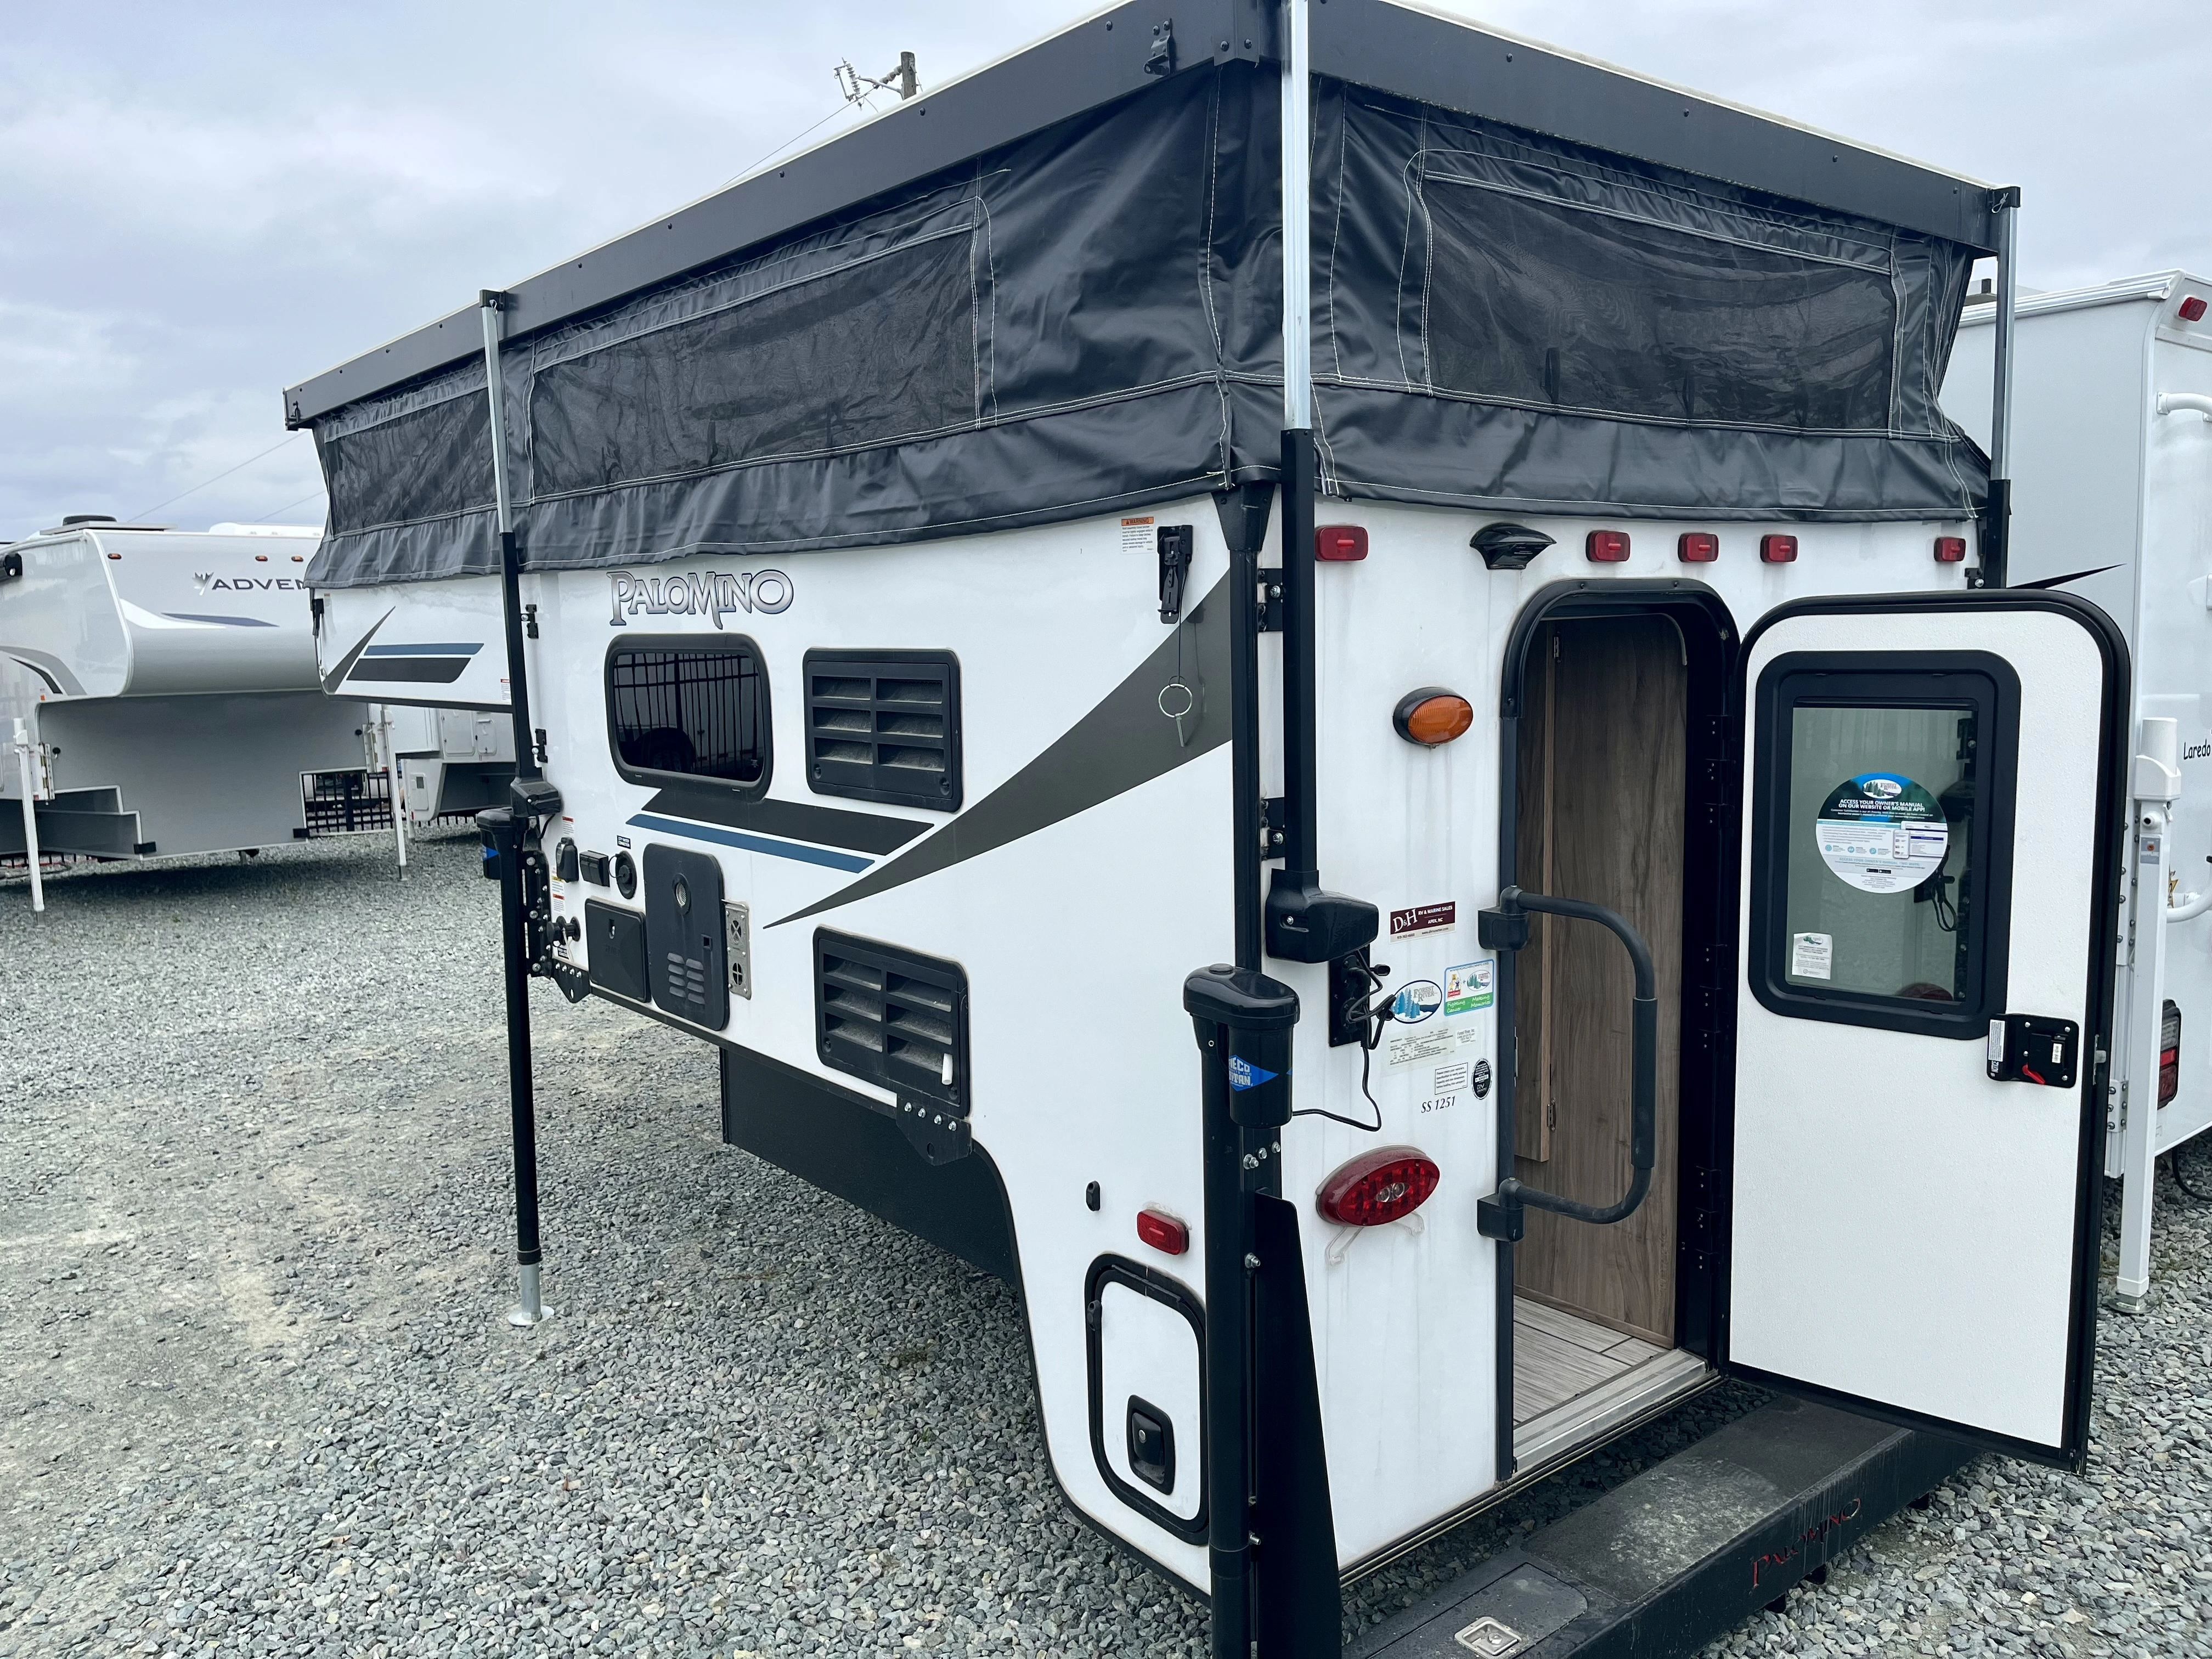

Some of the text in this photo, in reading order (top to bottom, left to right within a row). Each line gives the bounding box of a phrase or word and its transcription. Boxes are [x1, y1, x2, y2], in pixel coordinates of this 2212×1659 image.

[606, 569, 794, 630] PALOMINO
[2183, 738, 2211, 760] Laredo
[1392, 908, 1418, 933] D&H
[1413, 985, 1435, 998] FOREST
[1418, 991, 1435, 1002] RIVER
[1421, 1095, 1455, 1114] SS 1251
